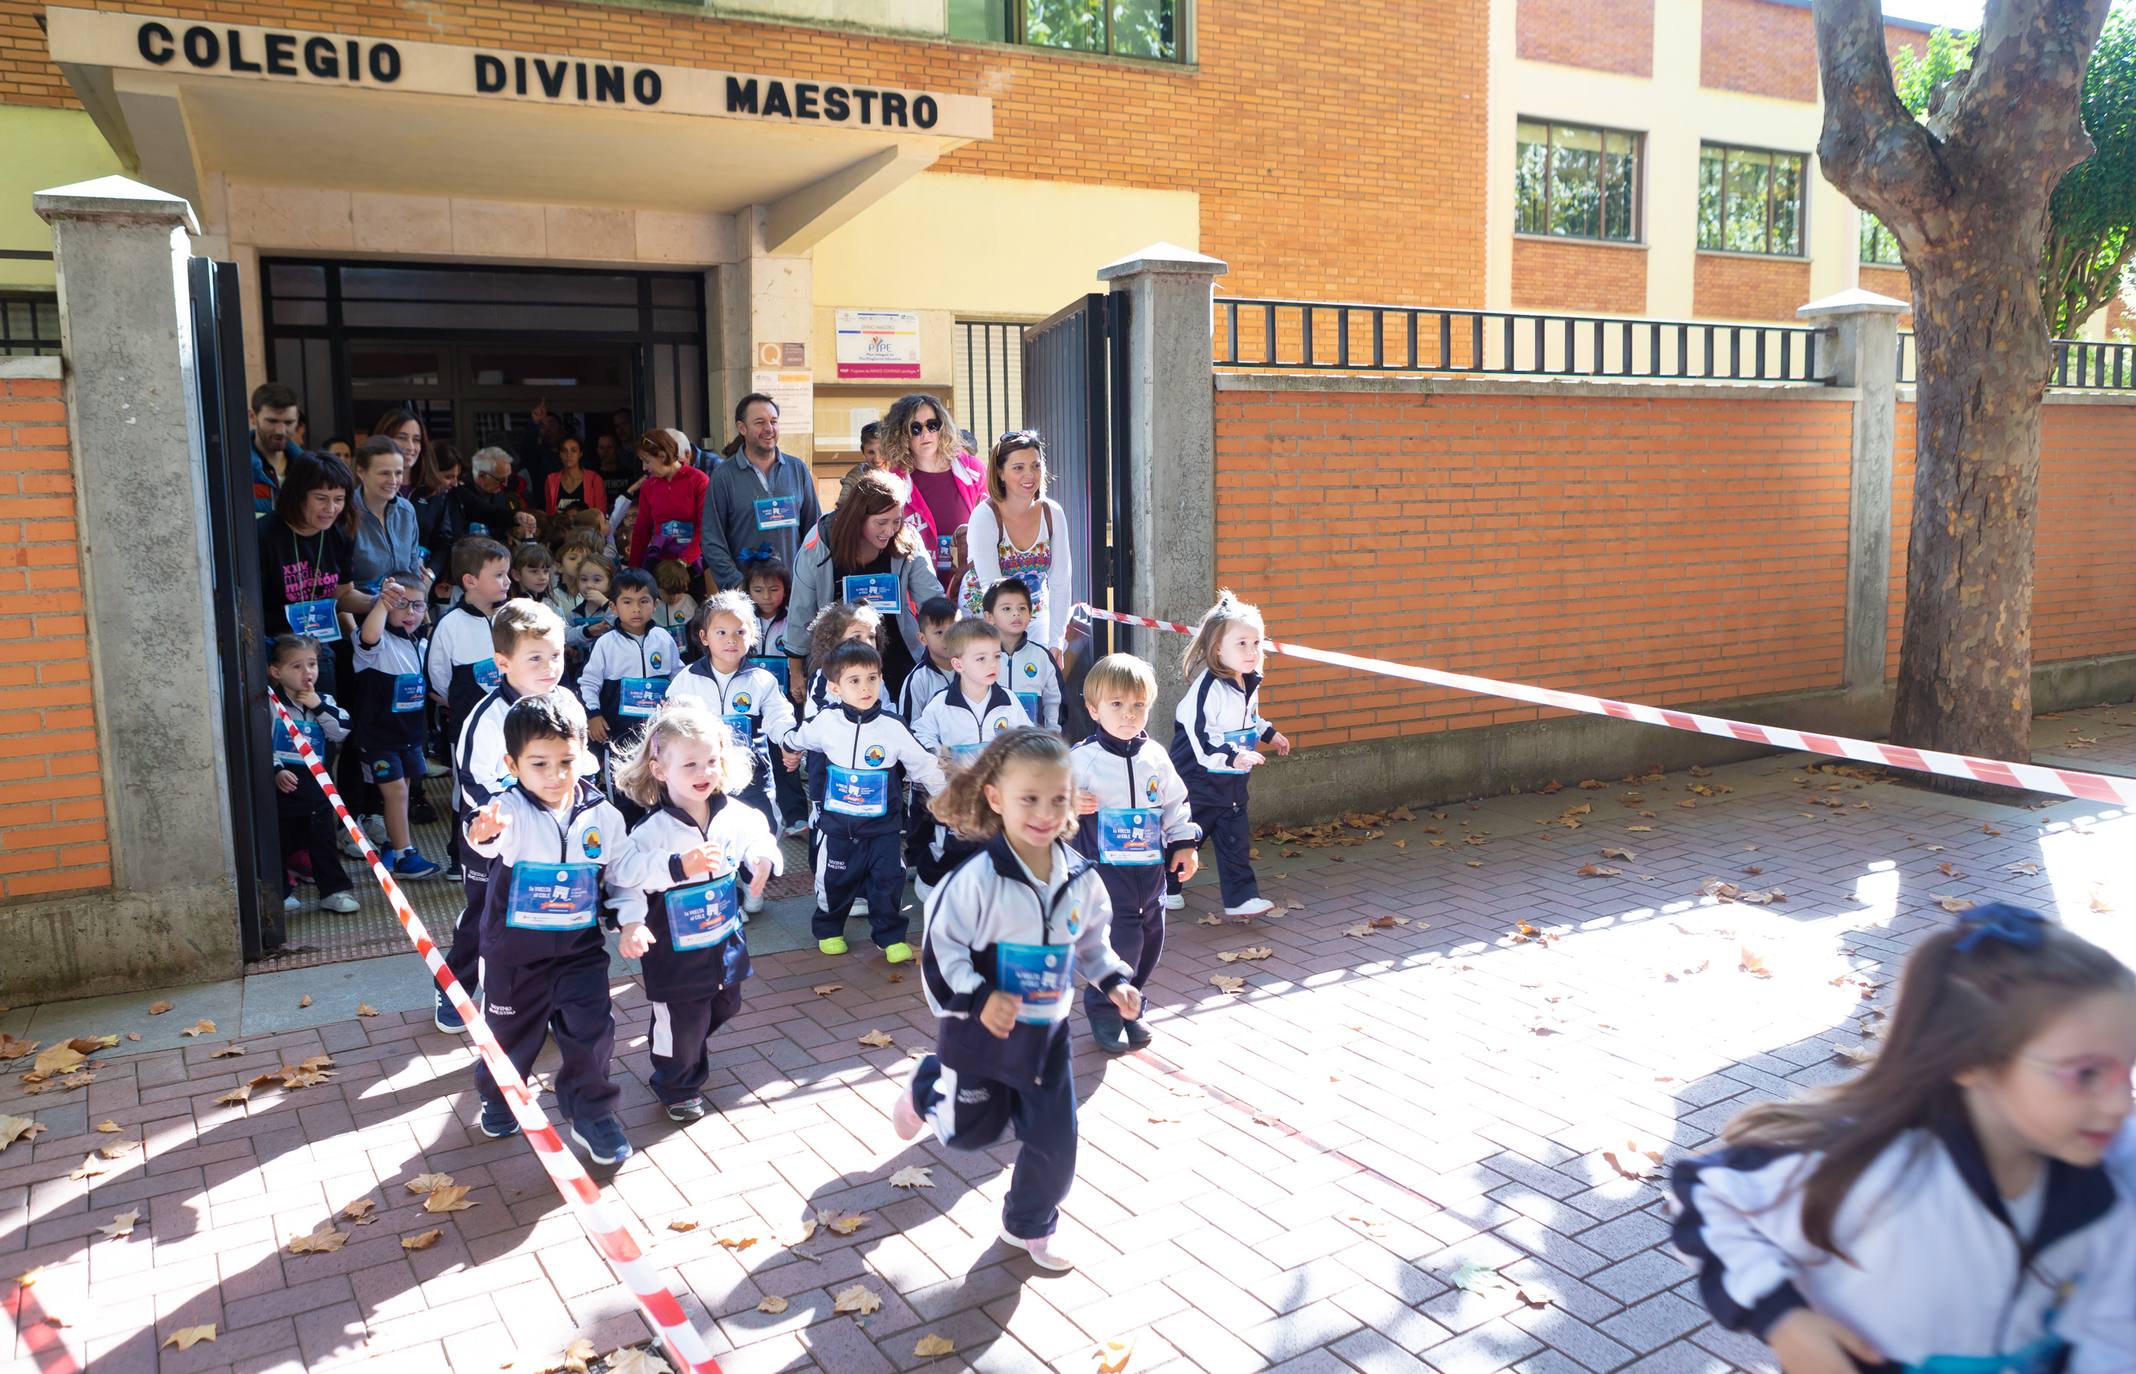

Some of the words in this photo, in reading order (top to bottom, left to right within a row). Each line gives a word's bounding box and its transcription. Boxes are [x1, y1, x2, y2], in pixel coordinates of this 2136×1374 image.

[137, 22, 401, 83] COLEGIO
[474, 54, 662, 105] DIVINO
[726, 77, 938, 129] MAESTRO
[761, 343, 781, 366] Q
[283, 561, 308, 576] XXV
